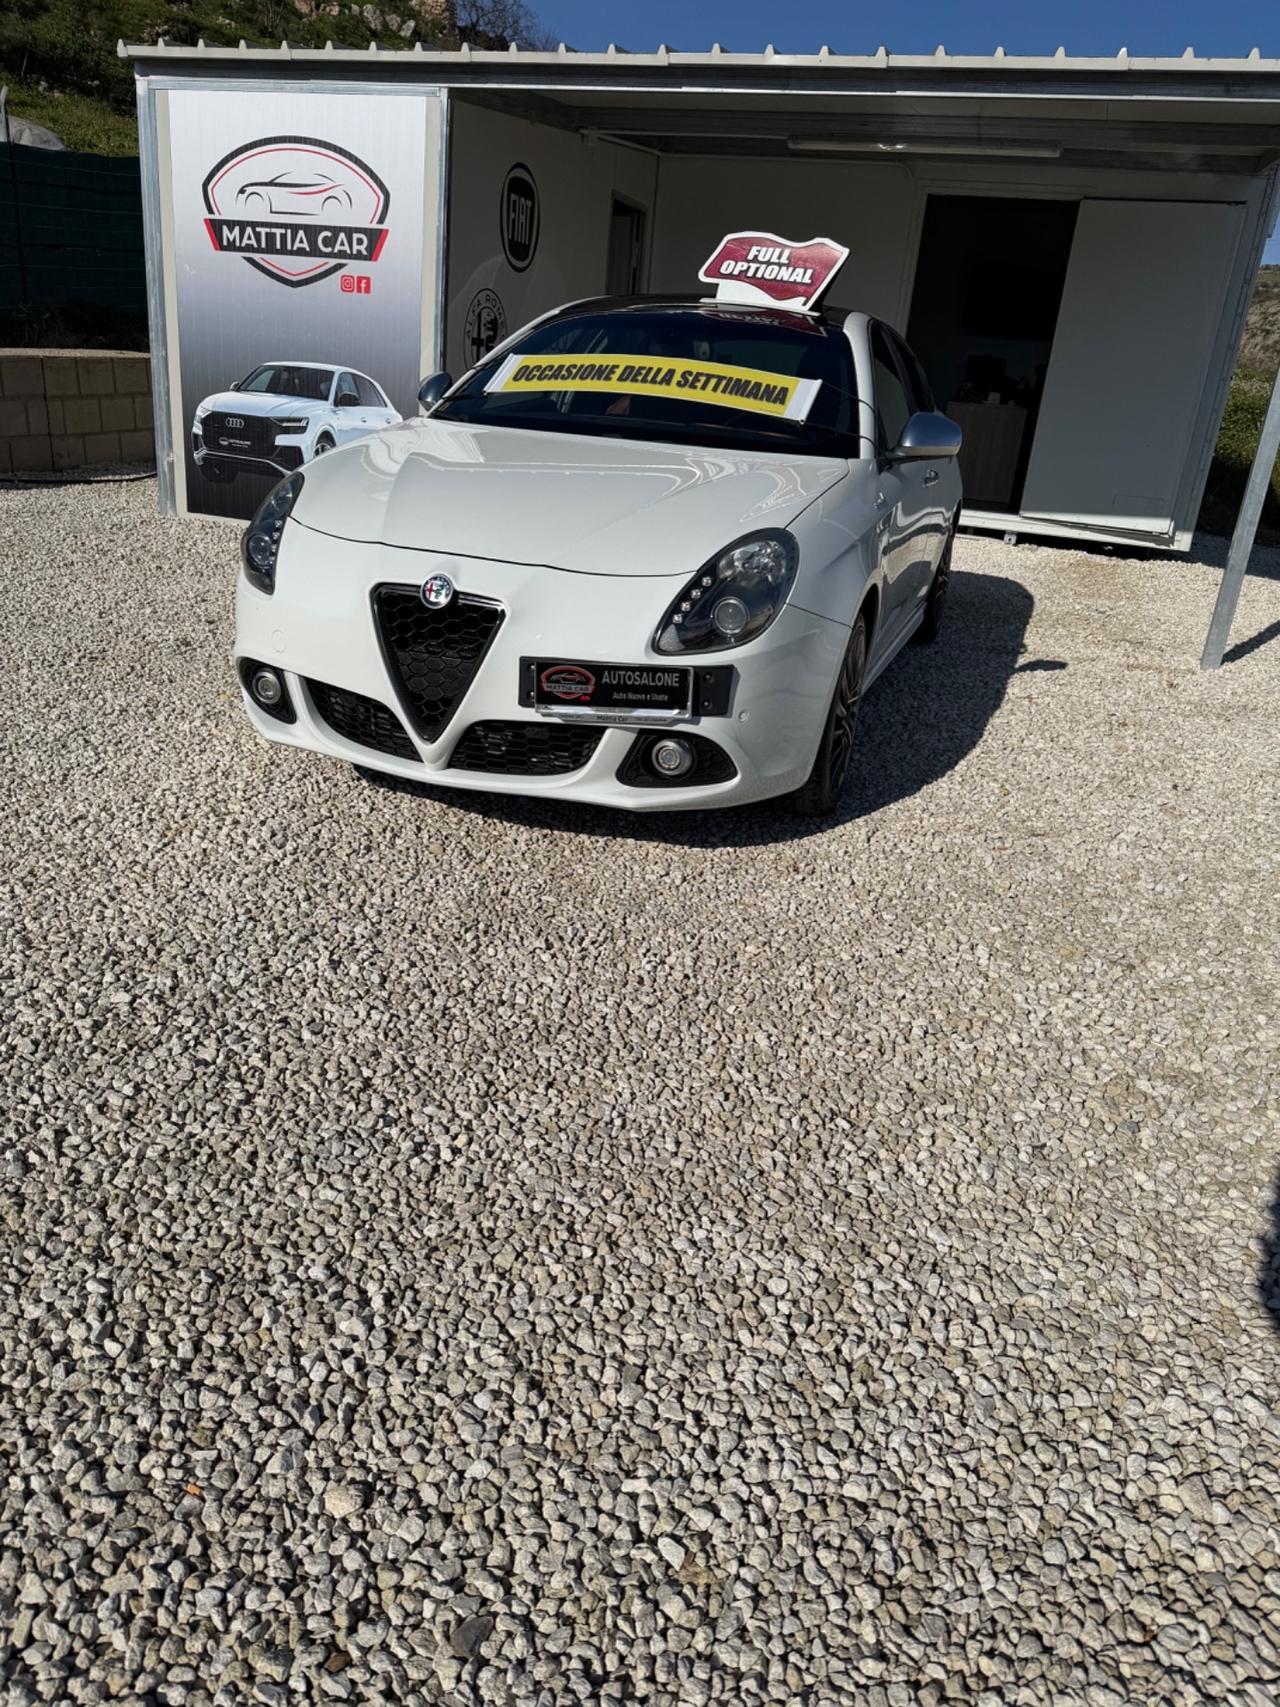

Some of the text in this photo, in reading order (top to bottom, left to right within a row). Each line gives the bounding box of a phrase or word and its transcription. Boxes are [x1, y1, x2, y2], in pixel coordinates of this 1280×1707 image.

[508, 192, 532, 245] FIAT
[222, 225, 368, 255] MATTIA CAR
[747, 246, 791, 264] FULL
[719, 260, 814, 284] OPTIONAL
[512, 364, 790, 406] OCCASIONE DELLA SETTIMANA
[602, 670, 680, 687] AUTOSALONE
[612, 691, 626, 700] Auto
